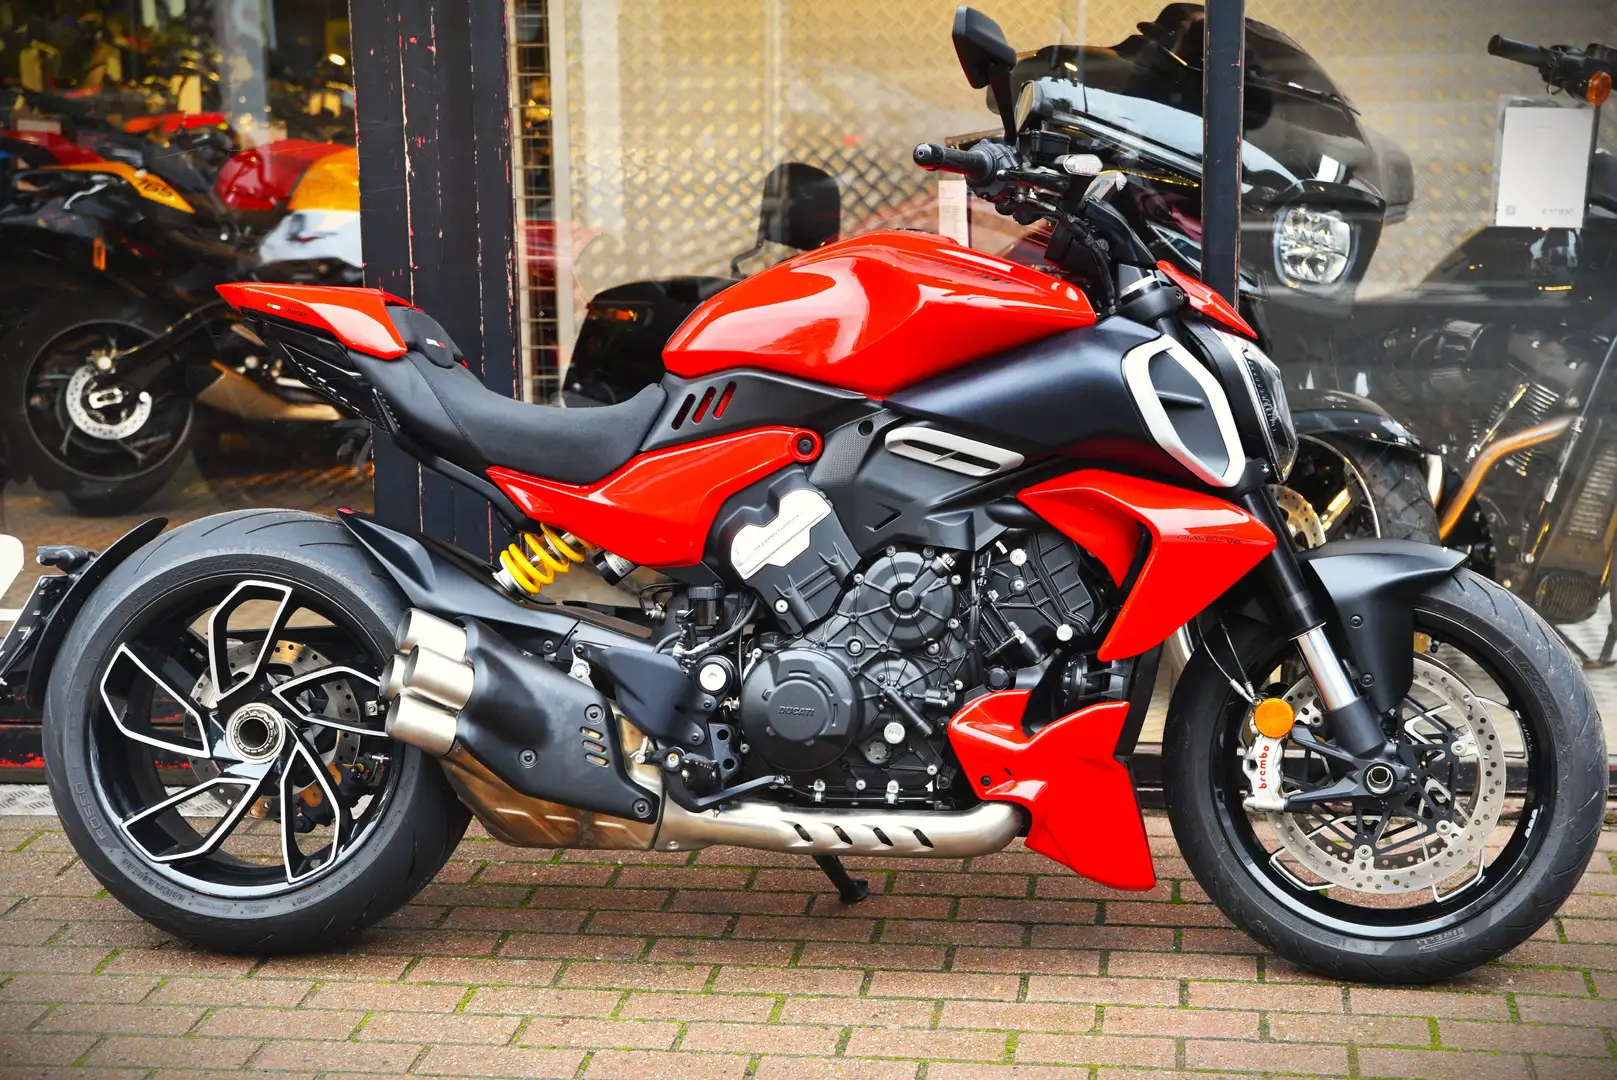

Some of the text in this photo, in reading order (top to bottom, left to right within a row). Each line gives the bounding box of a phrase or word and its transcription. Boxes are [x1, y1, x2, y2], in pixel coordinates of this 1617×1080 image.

[779, 705, 815, 717] DUCATI
[1258, 745, 1270, 790] brembo
[74, 781, 109, 841] ROSSO
[1416, 927, 1467, 951] PIRELLI
